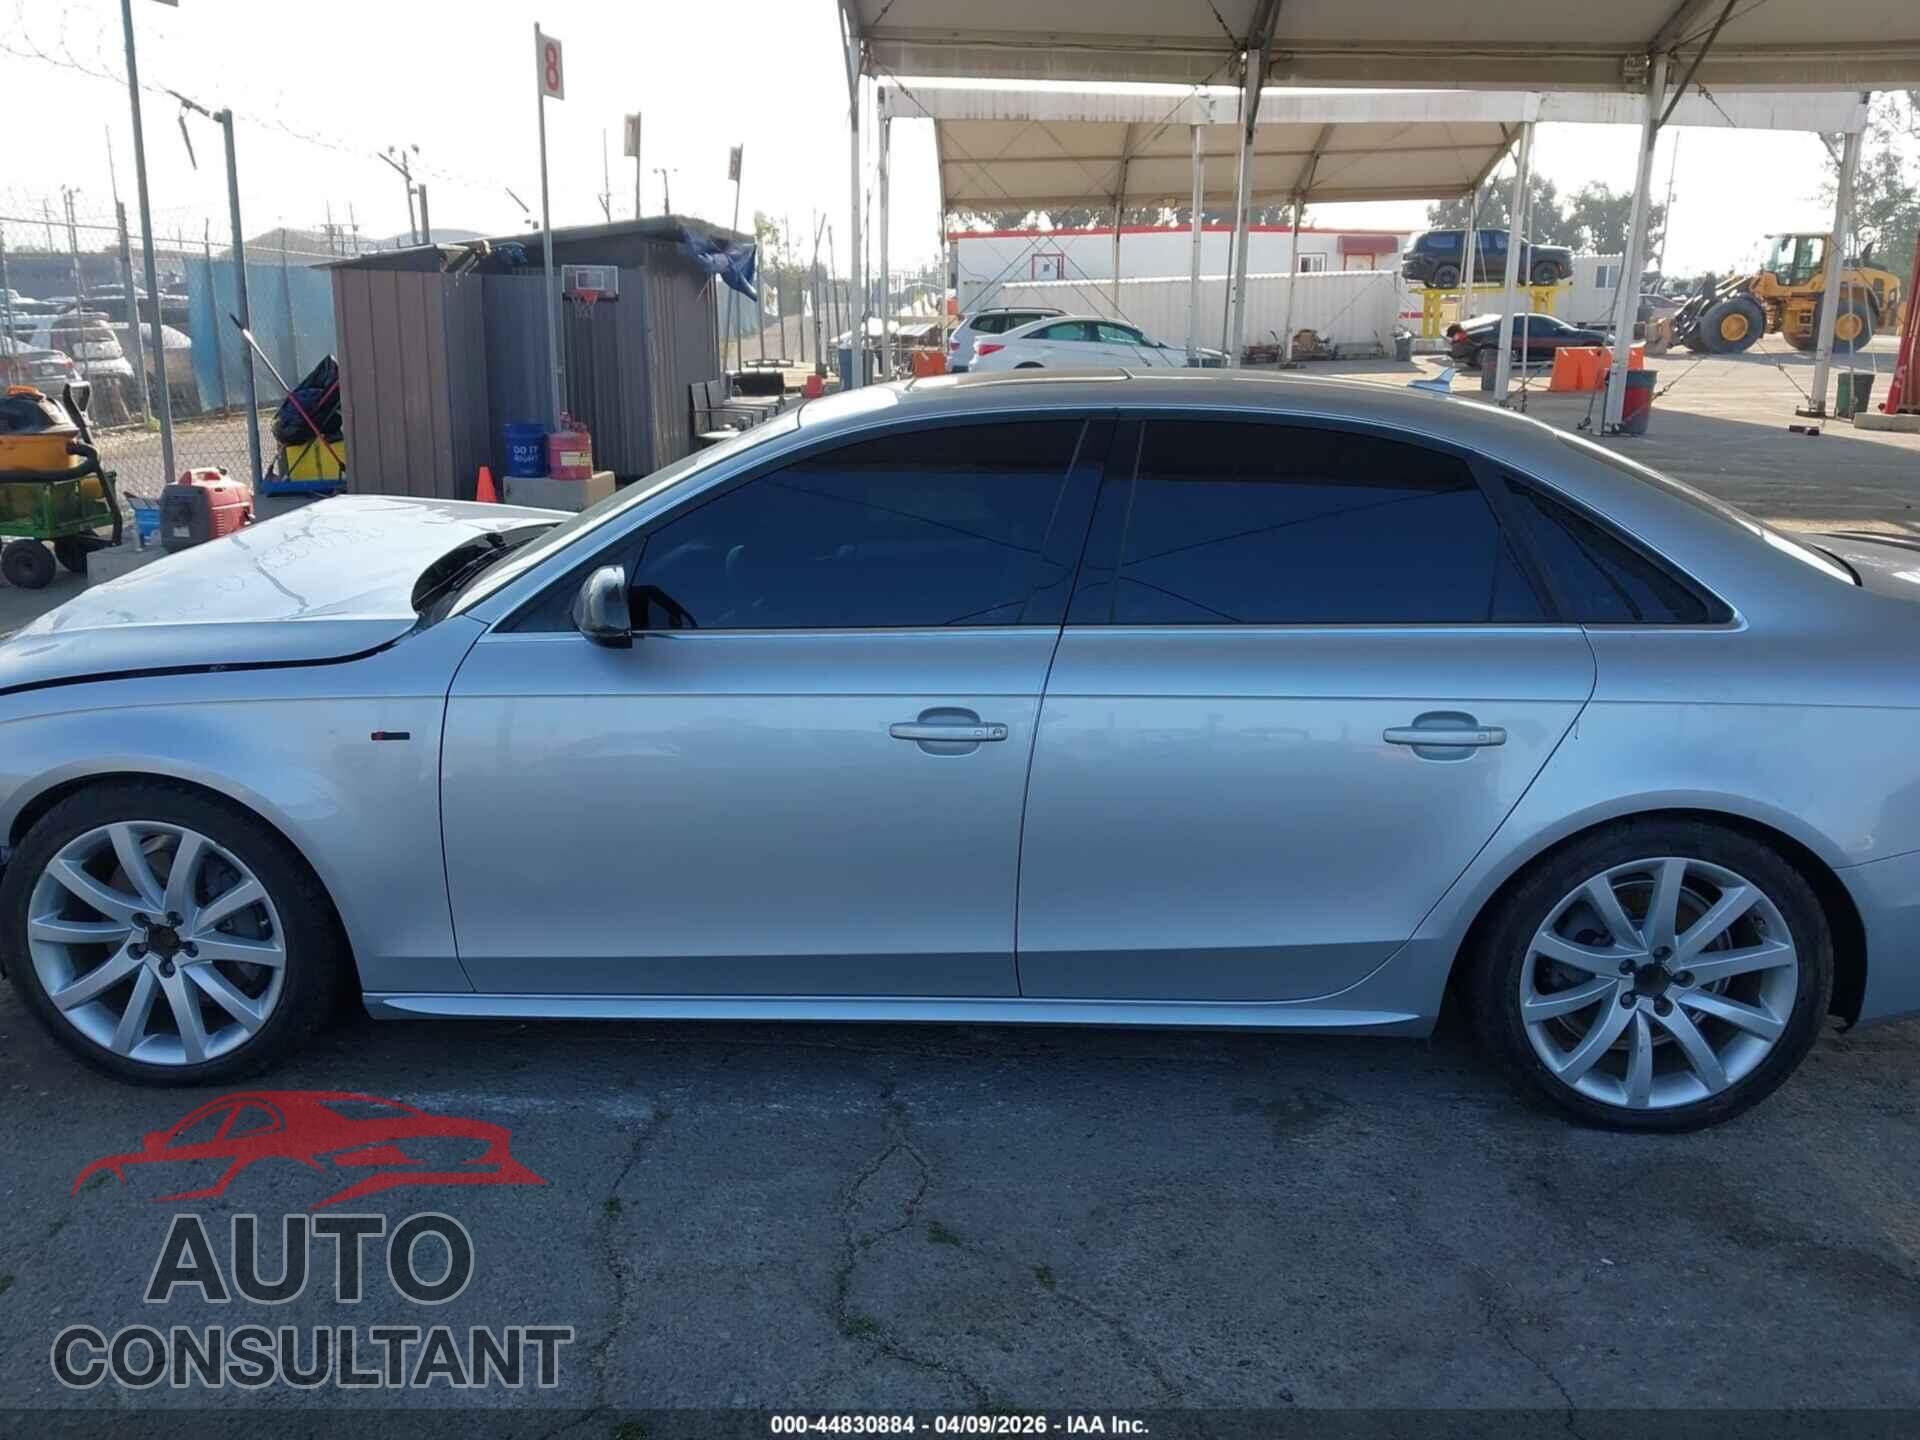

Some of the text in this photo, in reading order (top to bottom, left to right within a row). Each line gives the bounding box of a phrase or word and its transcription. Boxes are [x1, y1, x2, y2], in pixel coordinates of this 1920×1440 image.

[545, 42, 559, 91] 8
[513, 445, 539, 454] DO IT
